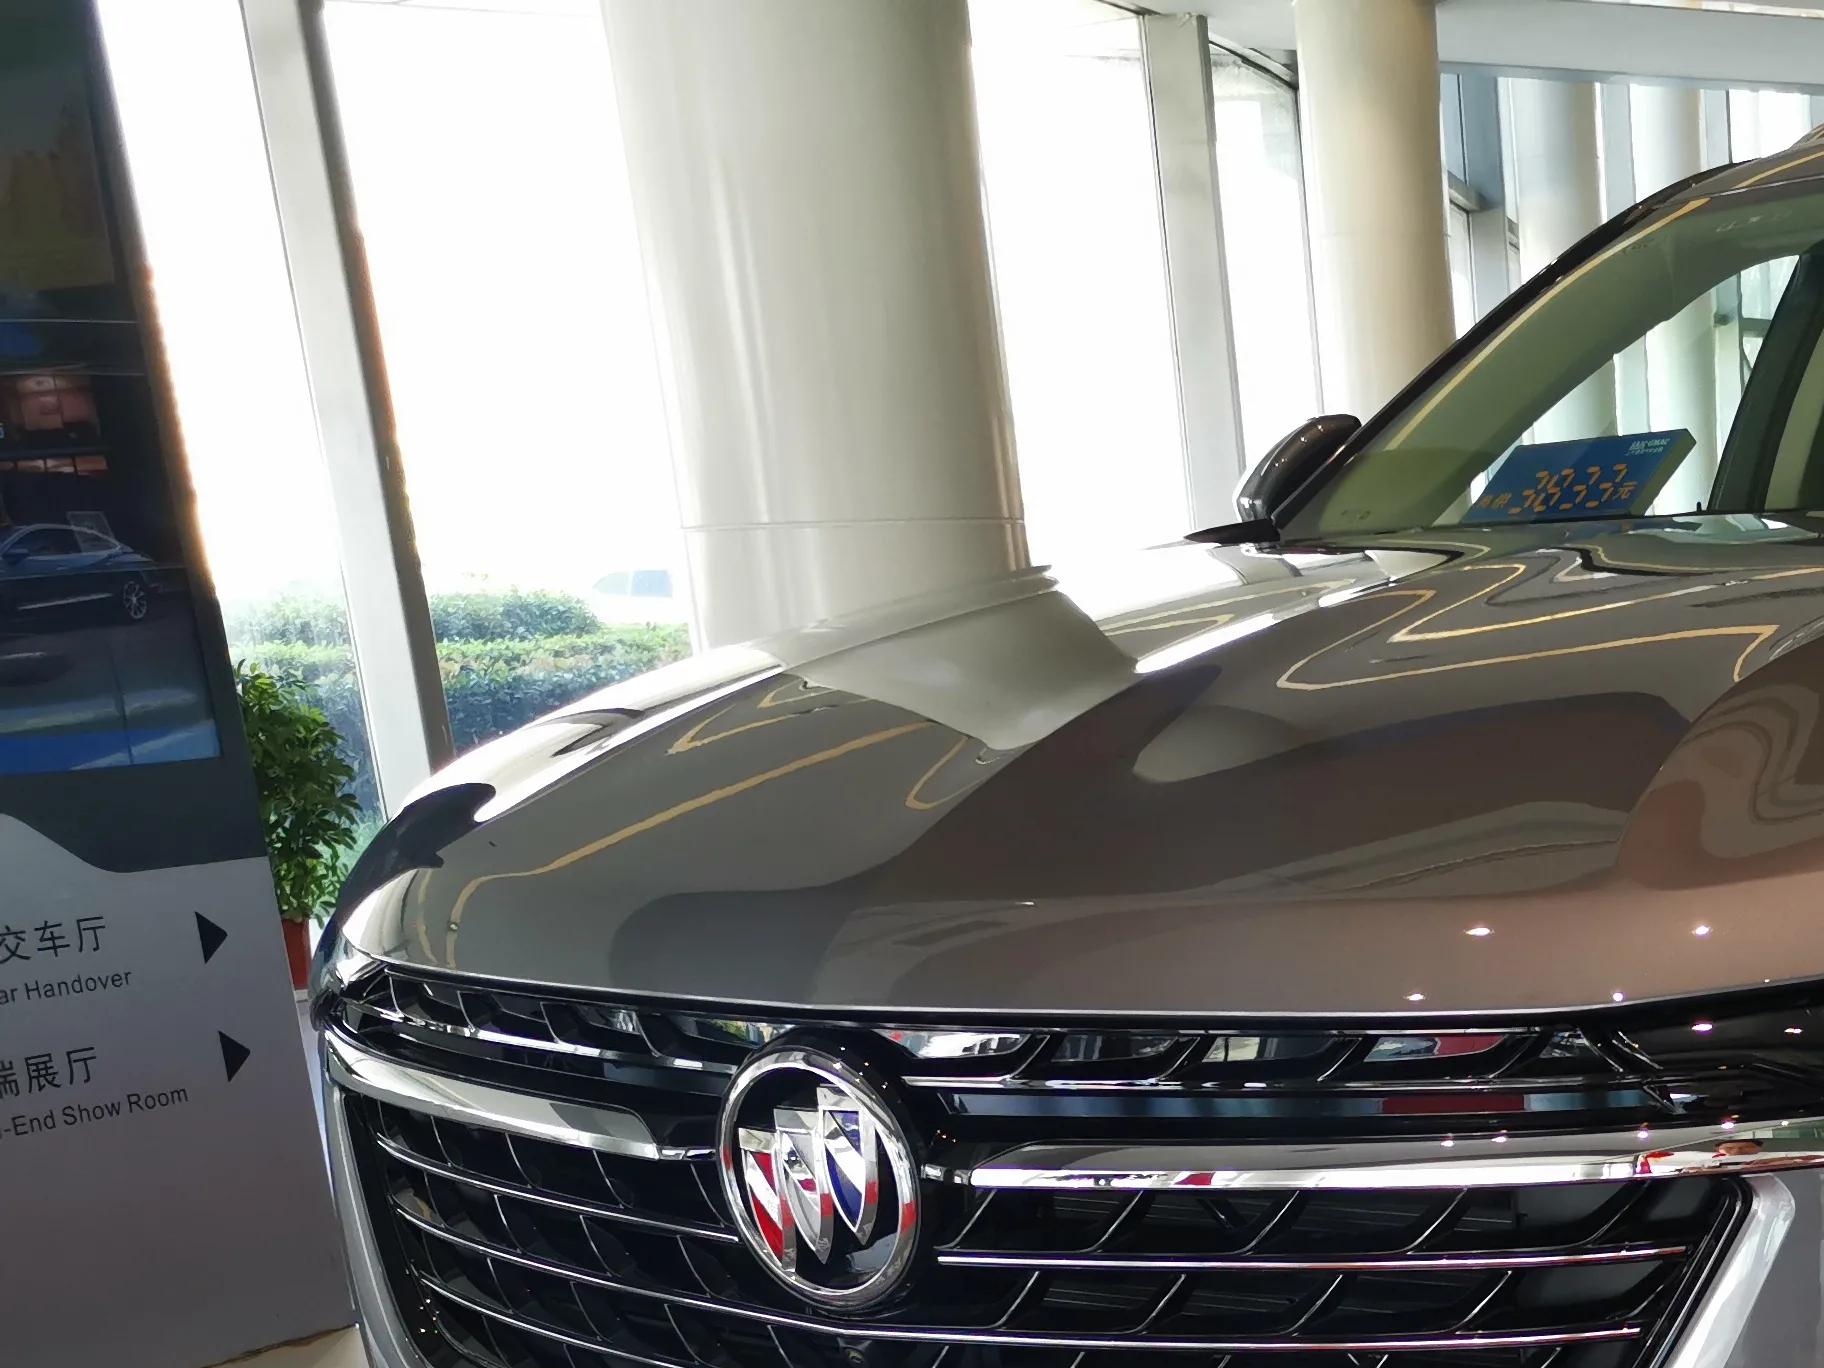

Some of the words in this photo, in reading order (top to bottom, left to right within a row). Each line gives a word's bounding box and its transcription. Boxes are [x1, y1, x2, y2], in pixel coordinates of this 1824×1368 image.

[0, 915, 106, 964] 交车厅
[24, 970, 133, 1001] Handover
[63, 1100, 121, 1126] Show
[127, 1086, 189, 1114] Room
